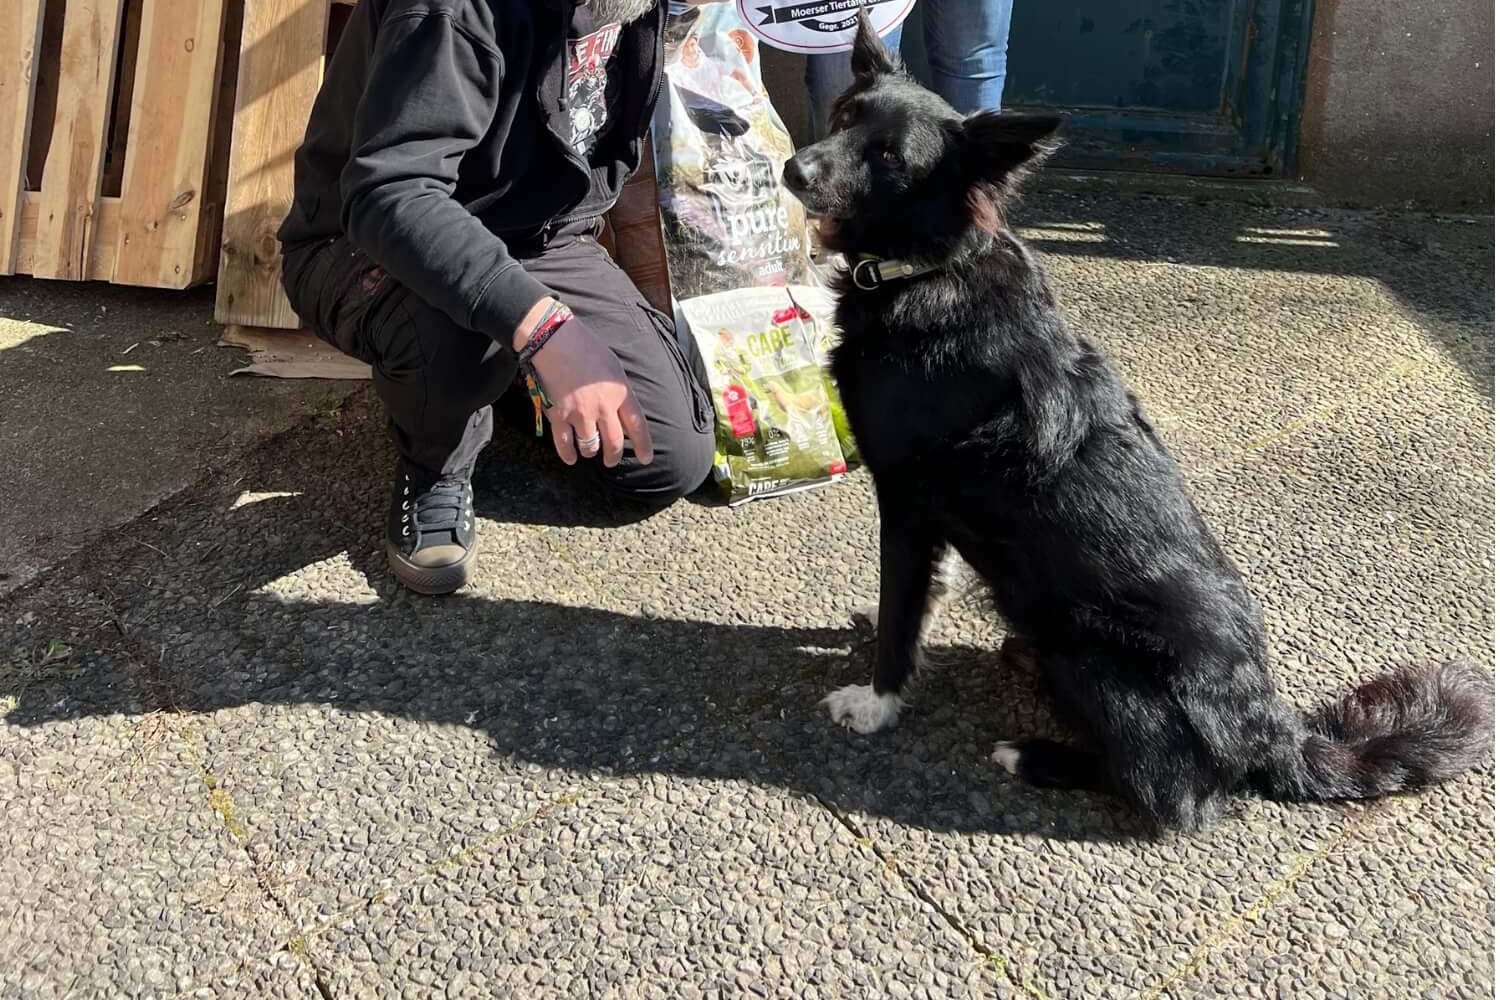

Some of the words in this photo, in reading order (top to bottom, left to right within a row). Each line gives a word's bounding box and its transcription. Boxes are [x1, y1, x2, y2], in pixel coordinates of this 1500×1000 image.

[791, 4, 828, 18] Moerser
[818, 22, 839, 31] Gegr.
[841, 15, 858, 28] 2021
[727, 206, 789, 246] pure
[746, 325, 795, 357] CARE
